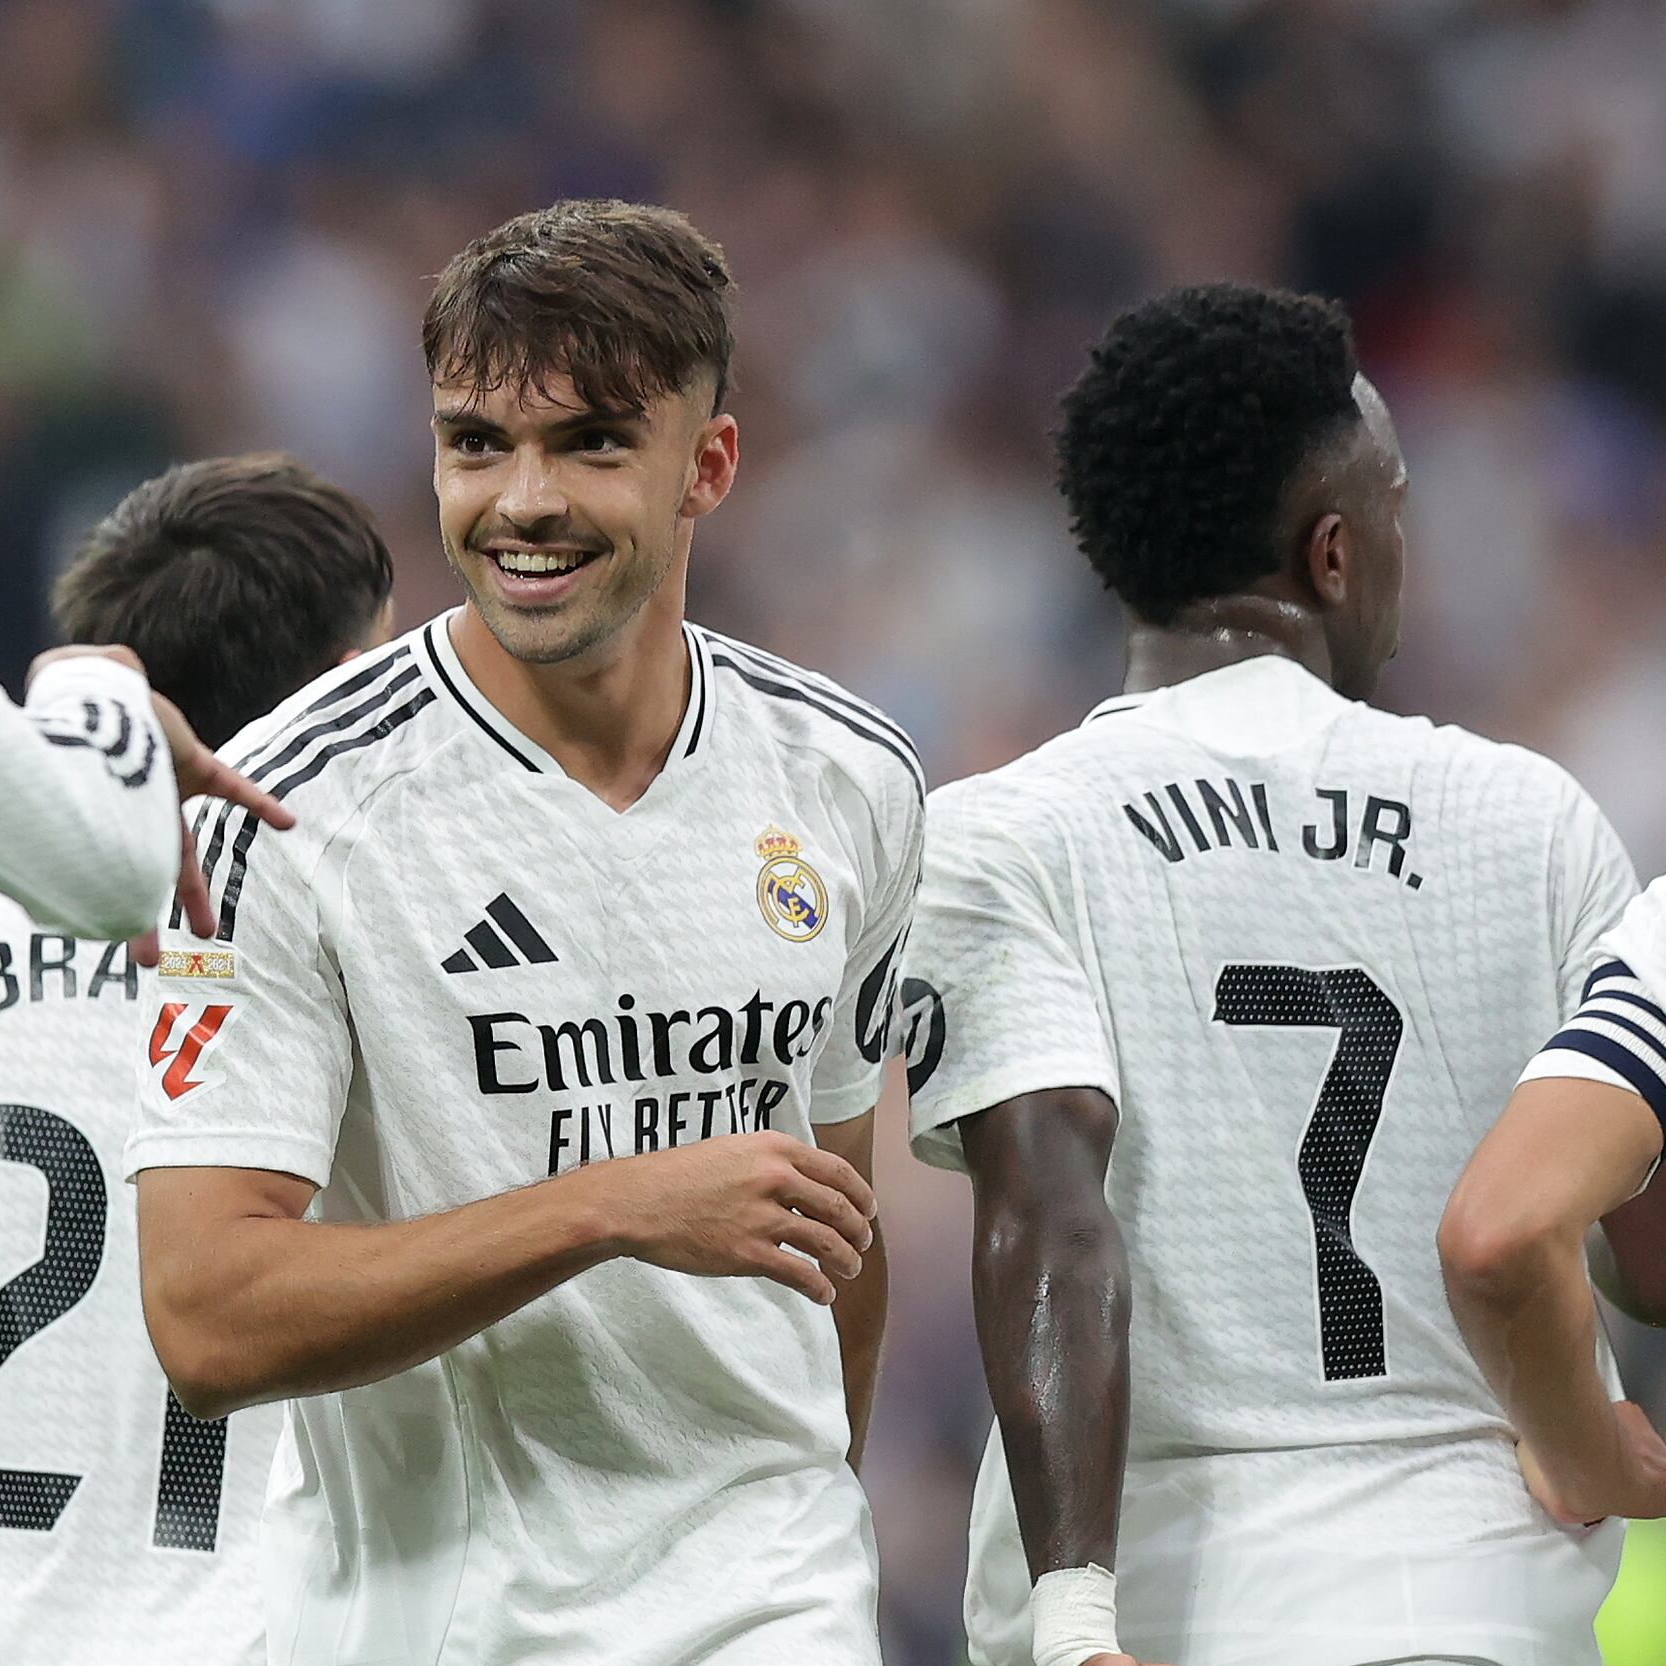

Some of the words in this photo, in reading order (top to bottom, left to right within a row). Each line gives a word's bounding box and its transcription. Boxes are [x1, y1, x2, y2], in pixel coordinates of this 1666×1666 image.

[1123, 777, 1279, 864] VINI
[1301, 787, 1423, 890] JR.
[466, 988, 833, 1095] Emirates
[634, 1078, 790, 1155] BETTER
[1211, 963, 1403, 1382] 7
